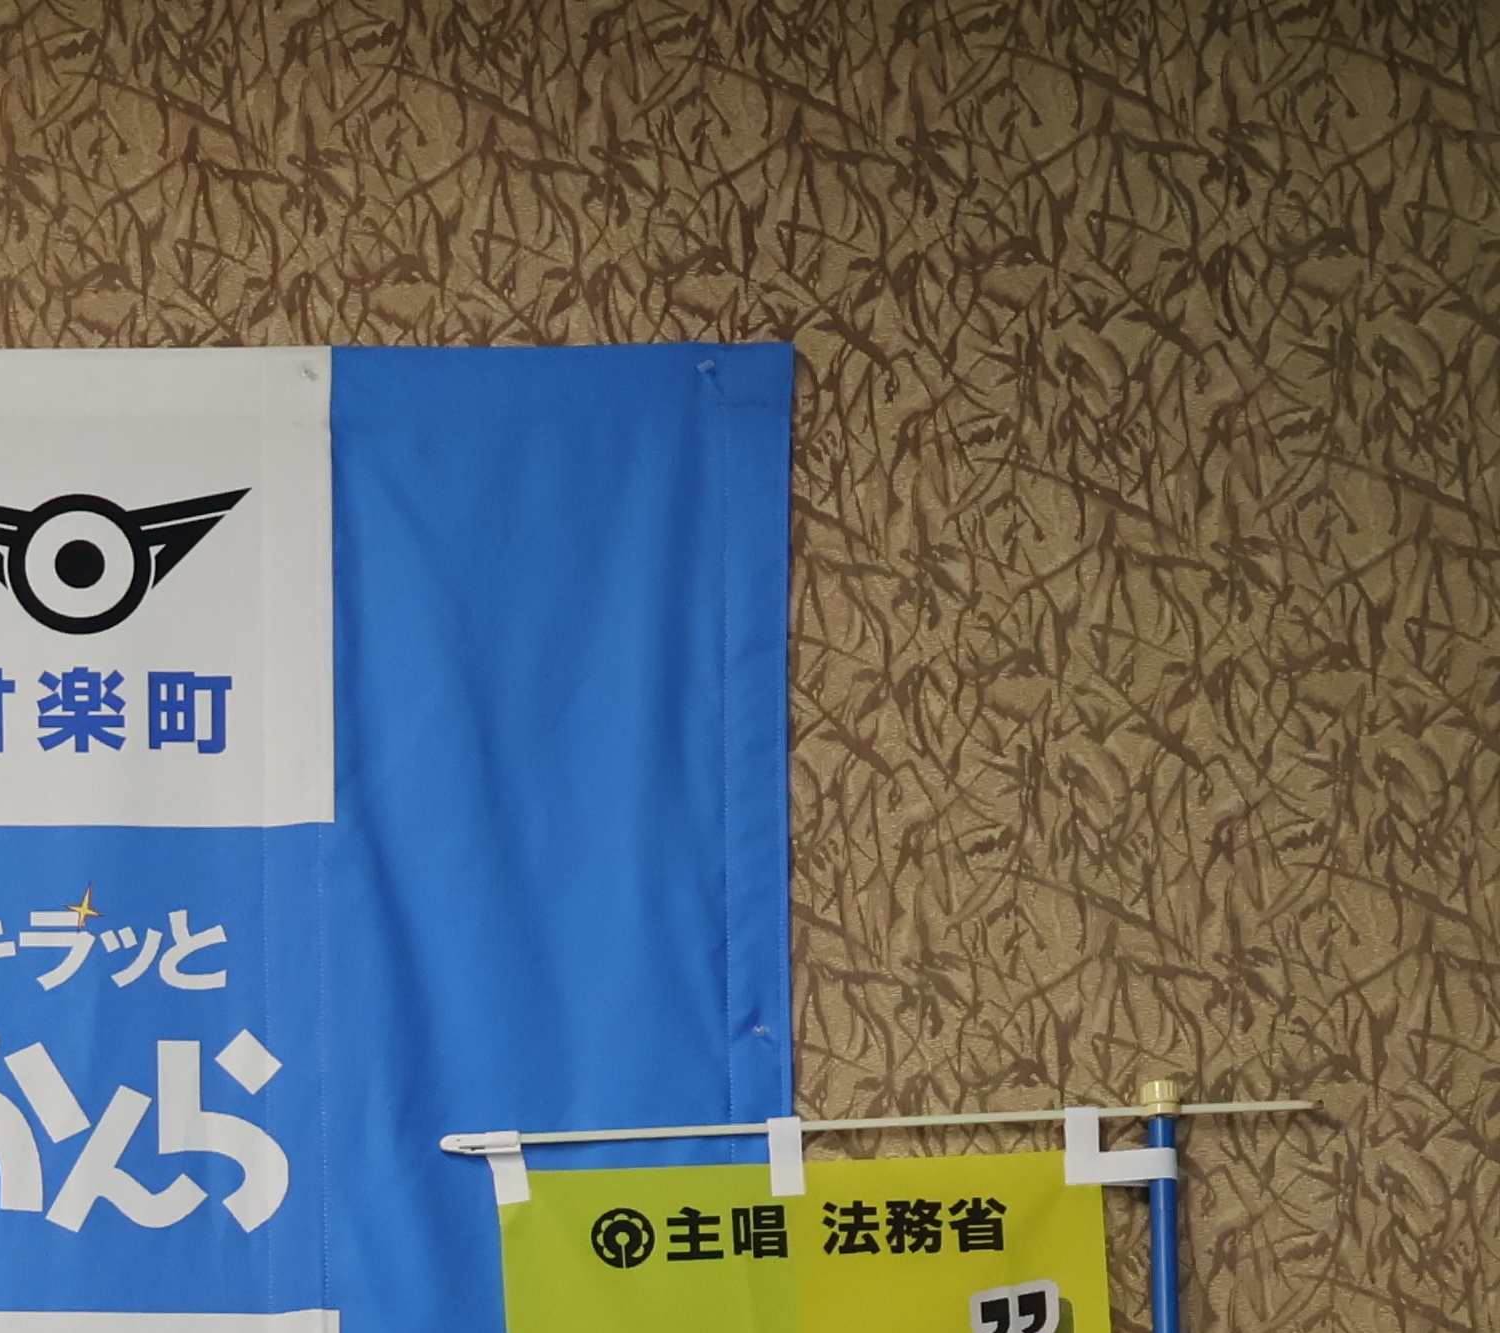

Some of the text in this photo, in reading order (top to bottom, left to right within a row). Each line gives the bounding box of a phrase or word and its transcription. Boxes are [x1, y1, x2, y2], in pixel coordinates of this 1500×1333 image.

[666, 1197, 1007, 1262] 主唱 法務省
